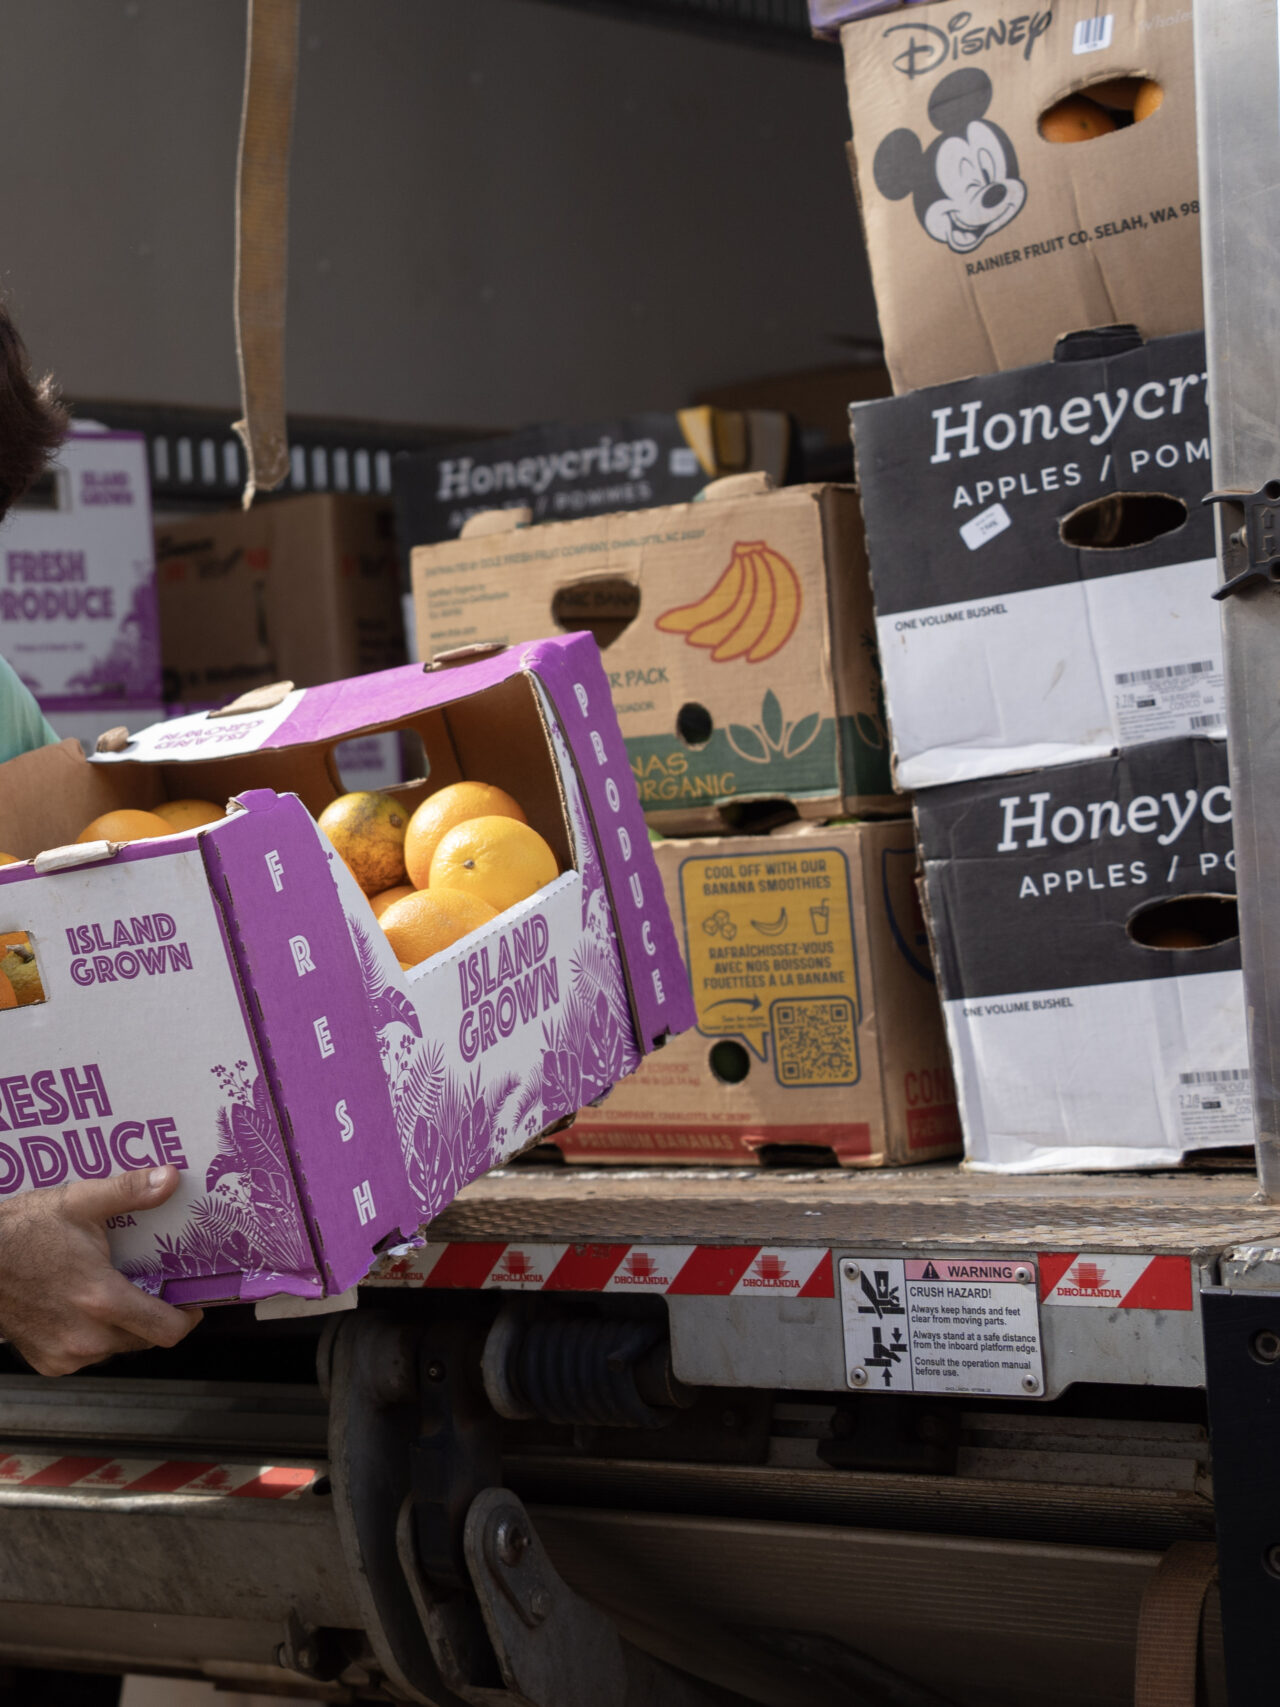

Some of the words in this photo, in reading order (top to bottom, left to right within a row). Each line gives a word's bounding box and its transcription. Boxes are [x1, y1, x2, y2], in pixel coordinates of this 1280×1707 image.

[965, 249, 1023, 277] RAINIER
[1024, 235, 1066, 260] FRUIT
[1067, 228, 1094, 248] CO.
[1095, 215, 1150, 241] SELAH,
[1150, 206, 1178, 226] WA
[1180, 200, 1201, 218] 98
[929, 371, 1209, 465] Honeycr
[437, 436, 659, 500] Honeycrisp
[952, 462, 1082, 510] APPLES
[1099, 455, 1112, 482] /
[1131, 437, 1211, 474] POM
[6, 550, 87, 585] FRESH
[894, 616, 918, 633] ONE
[919, 611, 965, 628] VOLUME
[966, 603, 1009, 621] BUSHEL
[625, 667, 670, 687] PACK
[630, 752, 689, 778] NAS
[997, 785, 1233, 852] Honeyc
[704, 865, 735, 880] COOL
[738, 863, 761, 878] OFF
[765, 861, 797, 876] WITH
[801, 859, 827, 873] OUR
[1019, 861, 1148, 899] APPLES
[1167, 855, 1180, 882] /
[703, 880, 756, 896] BANANA
[758, 875, 832, 893] SMOOTHIES
[65, 912, 178, 956] ISLAND
[69, 942, 194, 987] GROWN
[458, 913, 550, 1012] ISLAND
[714, 961, 743, 974] AVEC
[746, 959, 771, 973] NOS
[773, 956, 832, 972] BOISSONS
[780, 972, 794, 986] LA
[797, 970, 846, 986] BANANE
[458, 955, 561, 1064] GROWN
[962, 1005, 984, 1018] ONE
[985, 1001, 1031, 1016] VOLUME
[1032, 996, 1074, 1011] BUSHEL
[577, 1132, 655, 1149] PREMIUM
[656, 1134, 734, 1150] BANANAS
[105, 1213, 137, 1231] USA
[491, 1273, 544, 1283] DHOLLANDIA
[614, 1275, 669, 1286] DHOLLANDIA
[947, 1265, 1013, 1279] WARNING
[742, 1278, 801, 1288] DHOLLANDIA
[909, 1286, 944, 1299] CRUSH
[947, 1287, 992, 1299] HAZARD!
[1056, 1287, 1122, 1298] DHOLLANDIA
[911, 1304, 939, 1316] Always
[941, 1305, 959, 1317] keep
[961, 1305, 987, 1316] hands
[988, 1306, 1004, 1316] and
[1005, 1307, 1021, 1317] feet
[911, 1315, 931, 1324] clear
[932, 1315, 951, 1324] from
[953, 1316, 983, 1327] moving
[984, 1317, 1007, 1327] parts.
[913, 1330, 942, 1342] Always
[942, 1331, 967, 1341] stand
[968, 1332, 976, 1341] at
[976, 1333, 982, 1341] a
[983, 1332, 1000, 1342] safe
[1002, 1333, 1036, 1343] distance
[913, 1340, 932, 1349] from
[933, 1341, 947, 1350] the
[948, 1342, 979, 1351] inboard
[980, 1343, 1014, 1354] platform
[1015, 1344, 1038, 1355] edge.
[915, 1356, 946, 1366] Consult
[946, 1357, 960, 1367] the
[961, 1358, 1000, 1370] operation
[1001, 1360, 1031, 1370] manual
[915, 1367, 940, 1376] before
[942, 1369, 959, 1377] use.
